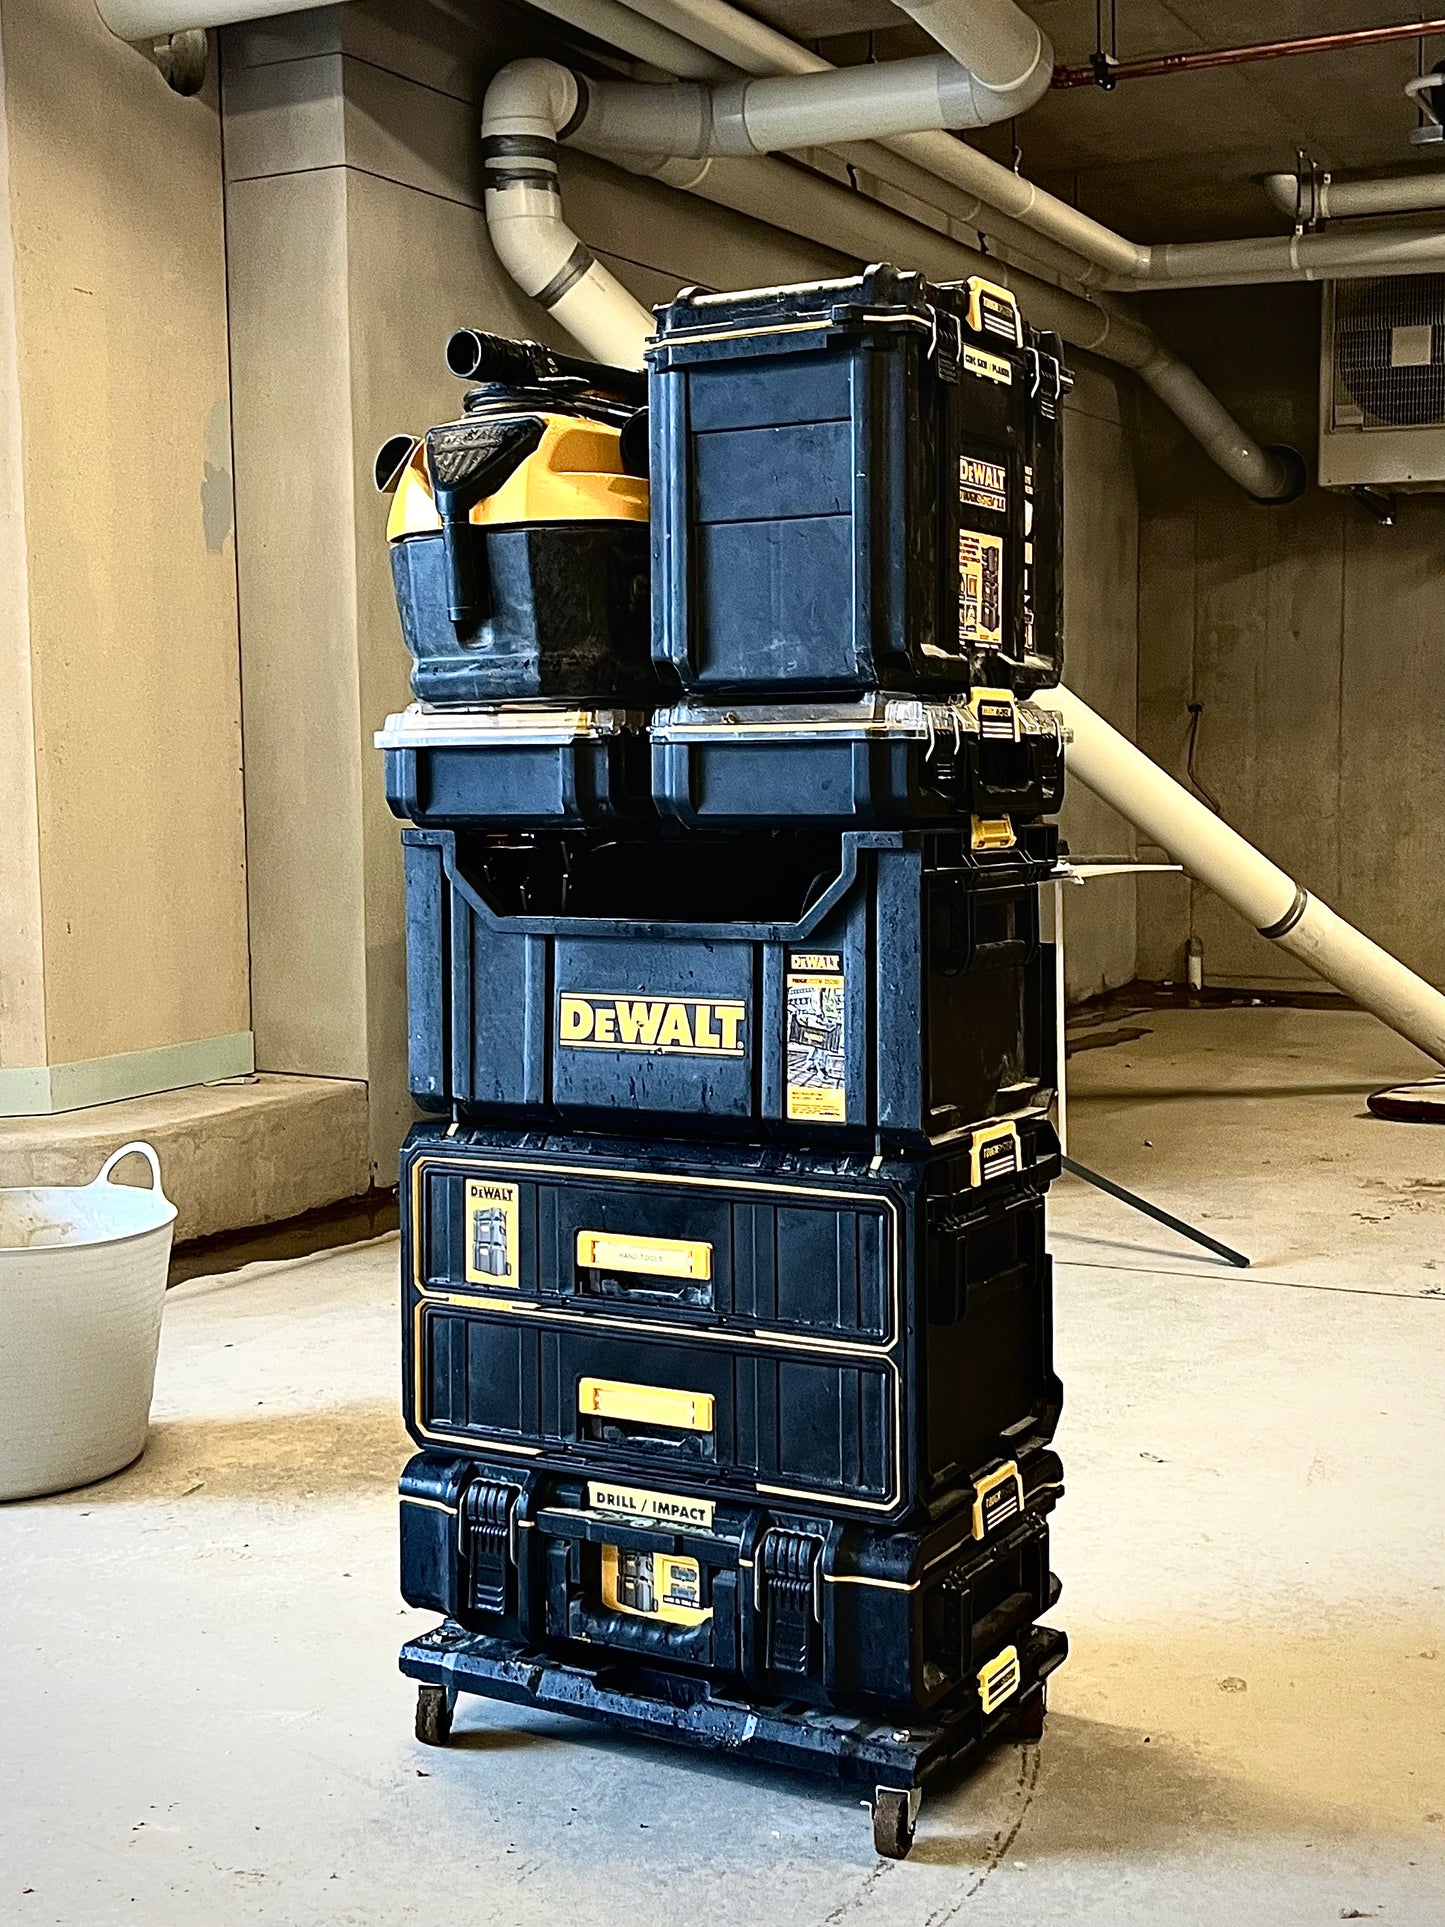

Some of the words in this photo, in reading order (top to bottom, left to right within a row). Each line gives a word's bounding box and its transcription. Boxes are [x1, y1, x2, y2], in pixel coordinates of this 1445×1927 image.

[560, 998, 746, 1050] DEWALT
[470, 1186, 513, 1201] DEWALT
[618, 1252, 639, 1260] HAND
[640, 1254, 663, 1262] TOOLS
[596, 1492, 637, 1509] DRILL
[641, 1499, 647, 1512] /
[652, 1501, 706, 1521] IMPACT
